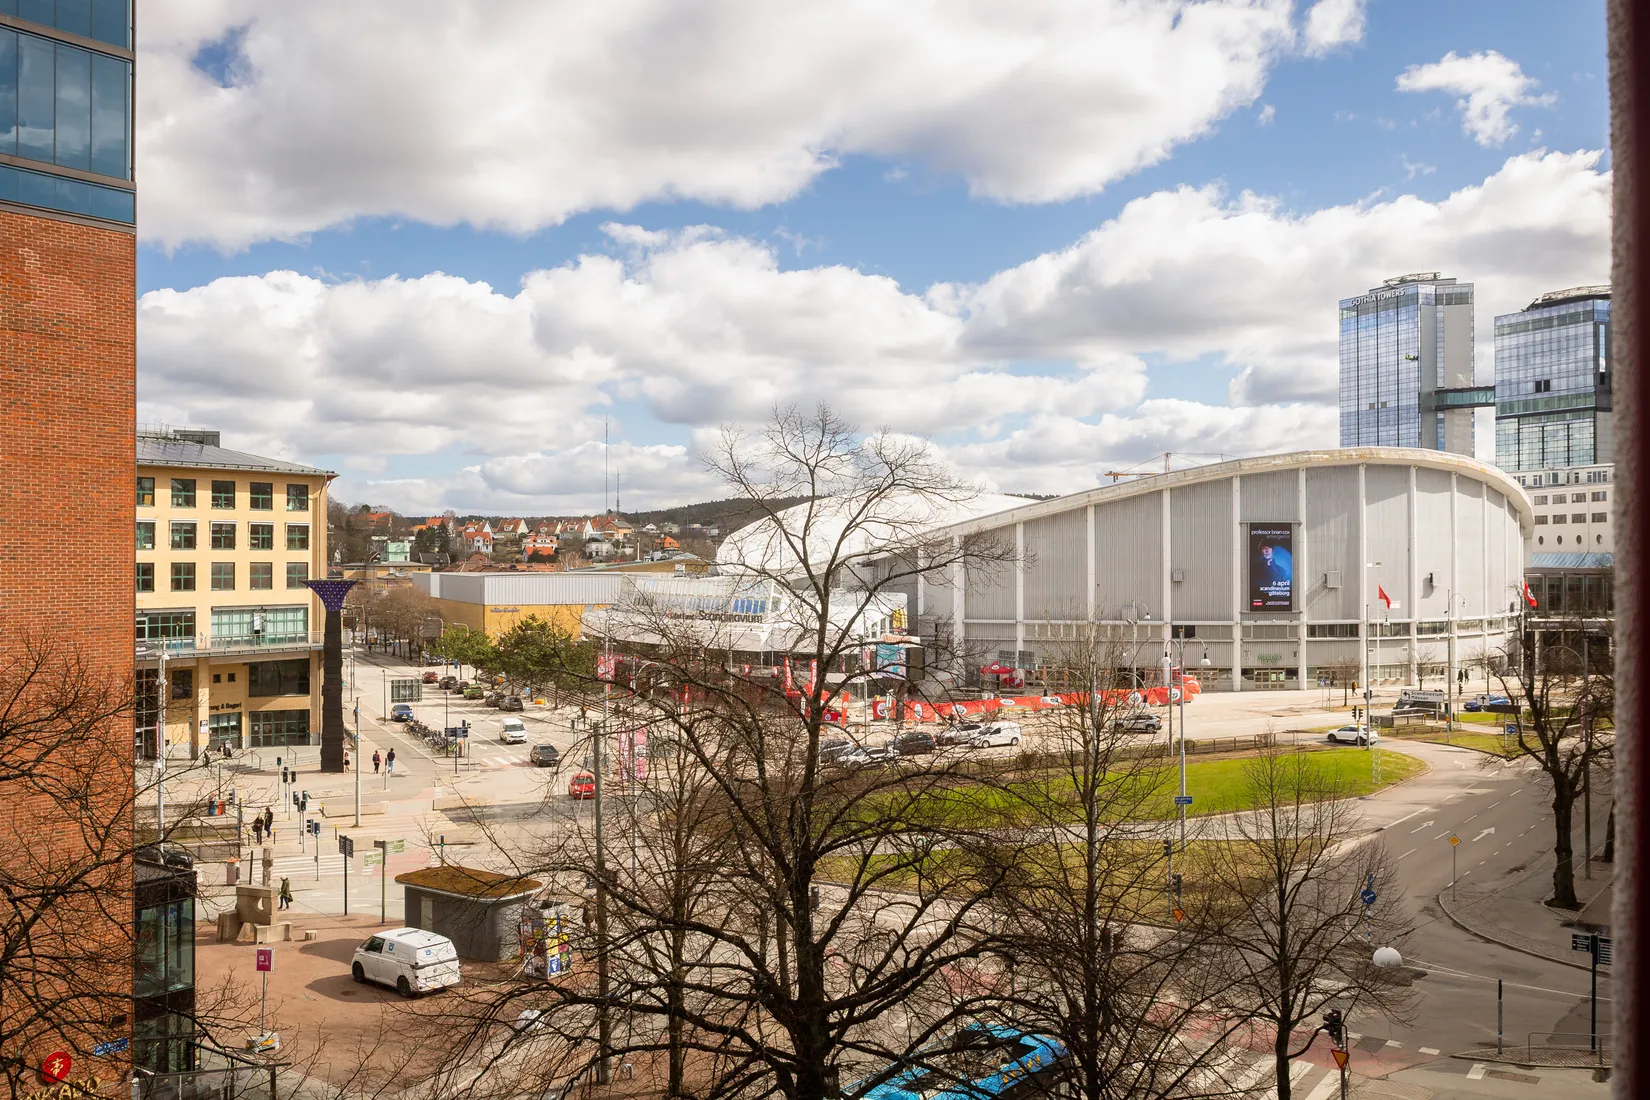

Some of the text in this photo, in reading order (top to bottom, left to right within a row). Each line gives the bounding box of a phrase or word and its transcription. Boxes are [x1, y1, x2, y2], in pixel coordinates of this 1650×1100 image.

[1350, 287, 1406, 307] GOTHIA TOWERS
[699, 609, 763, 624] Scandinavium
